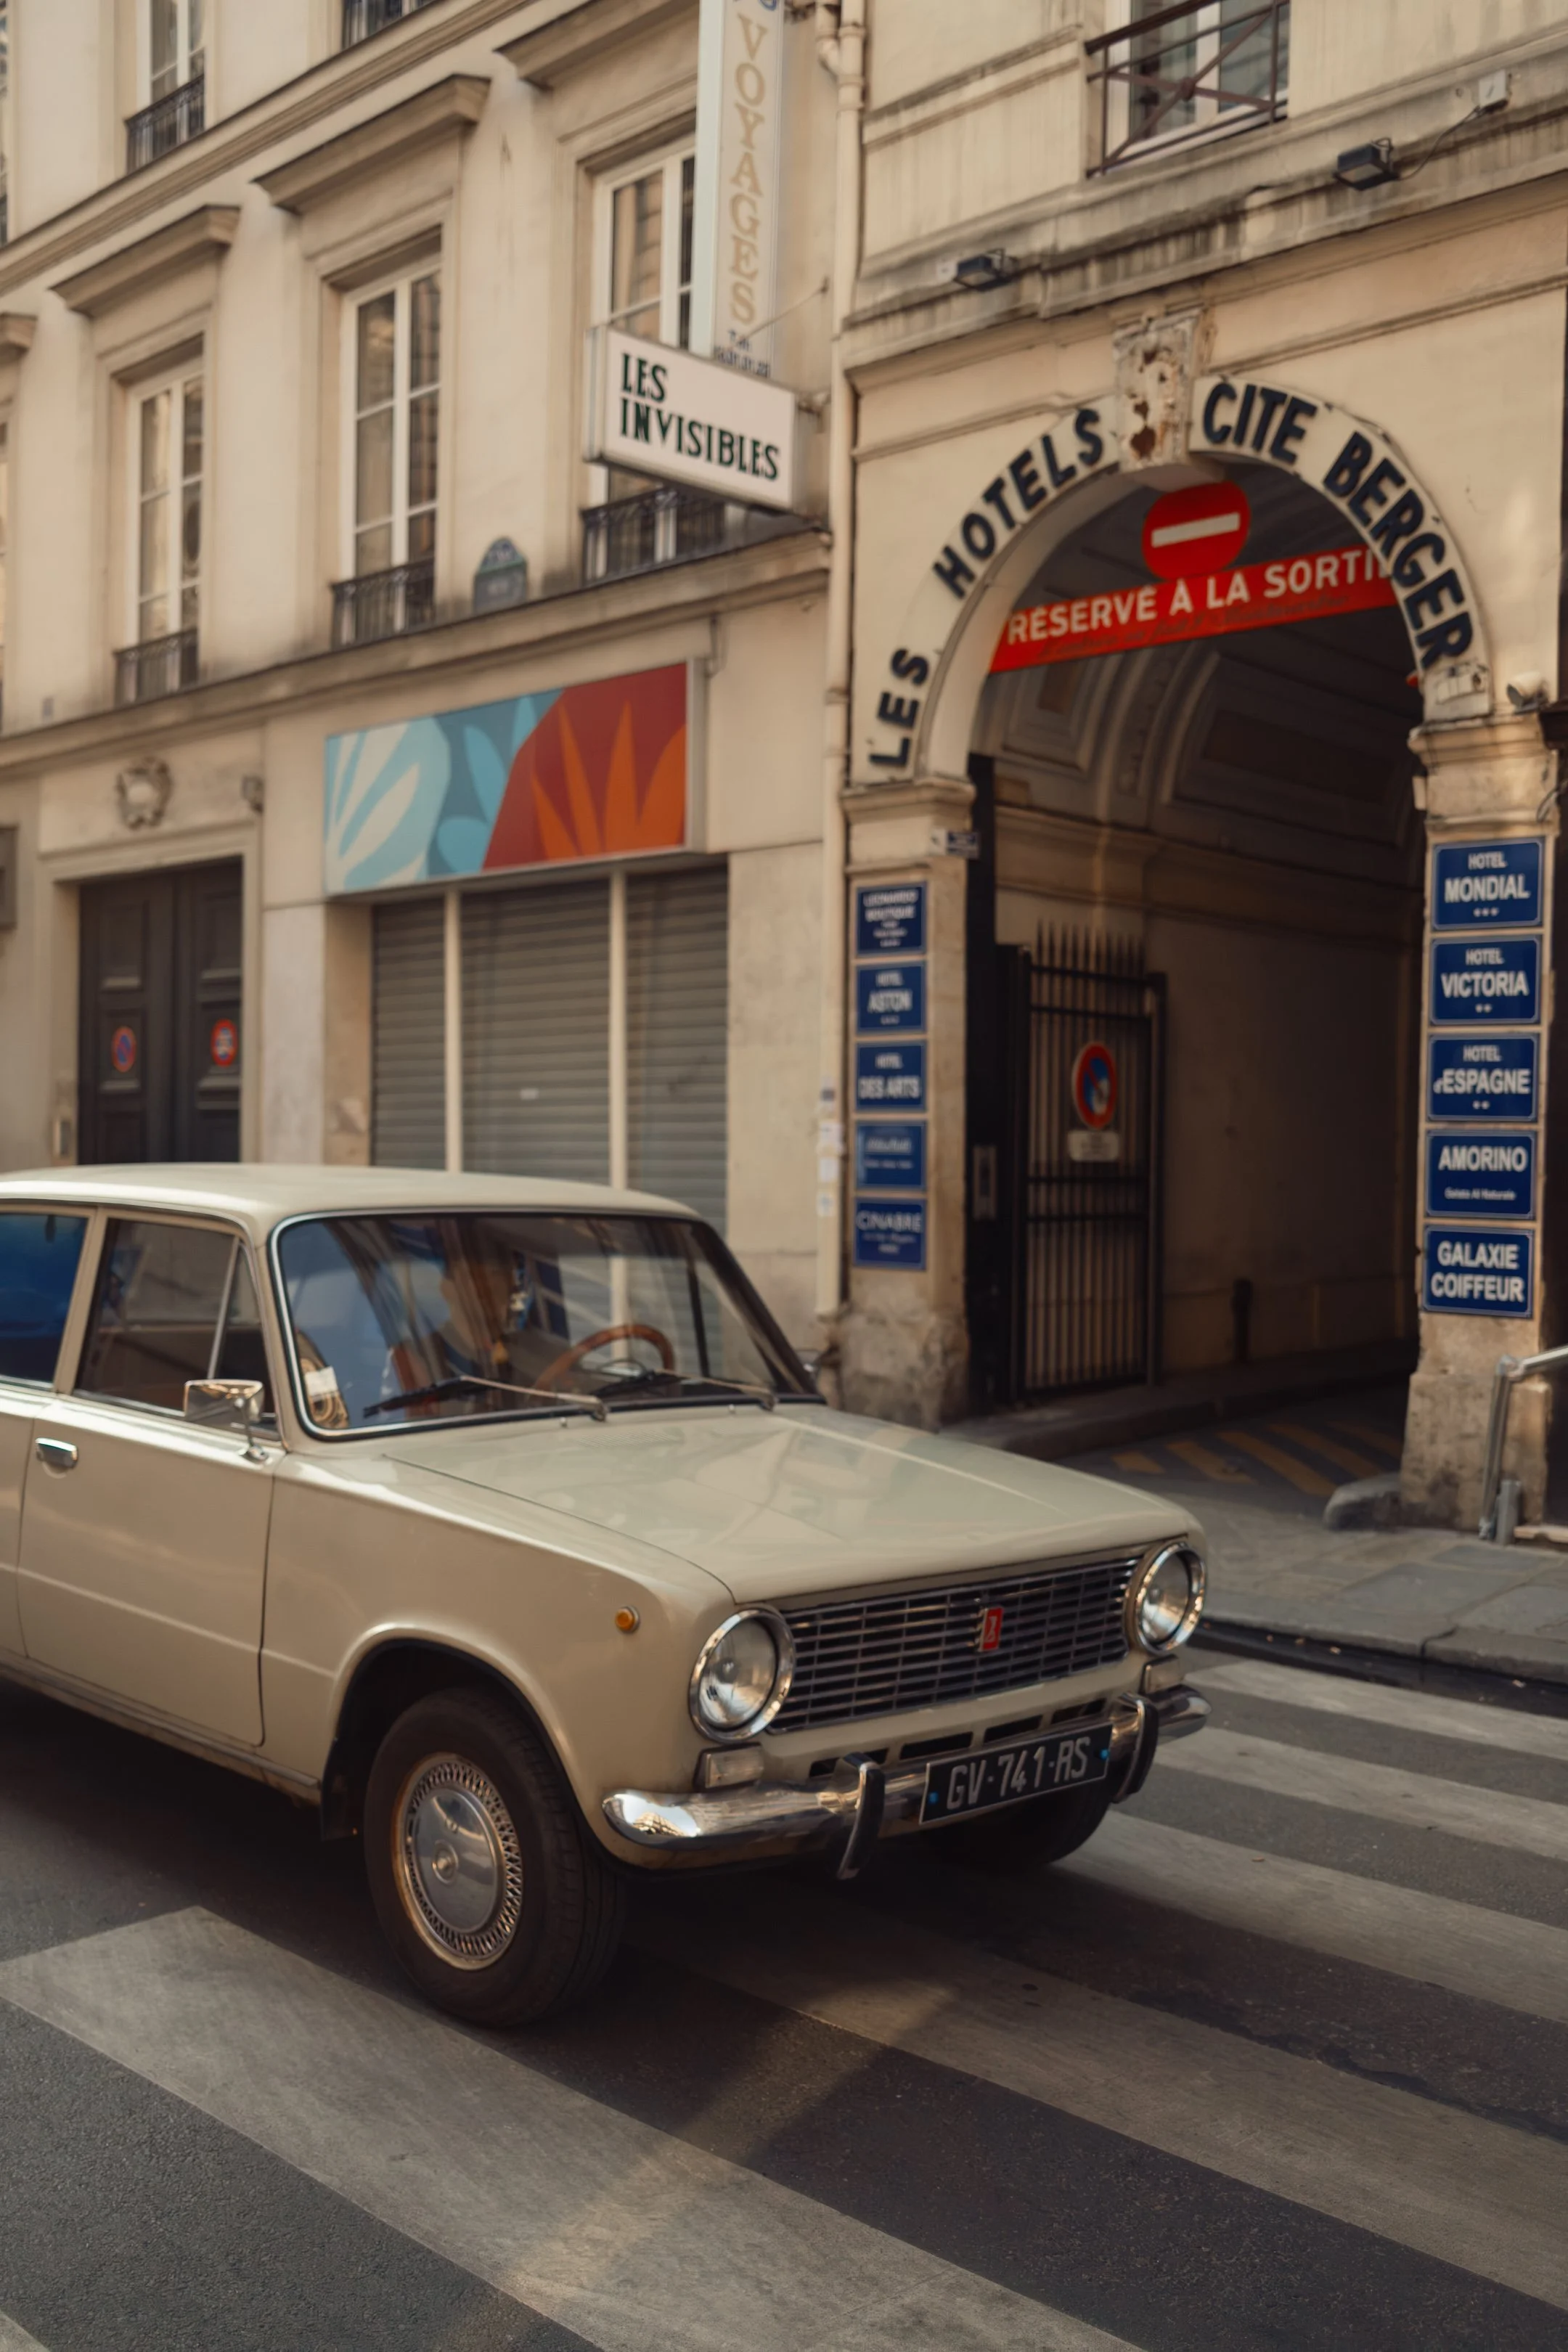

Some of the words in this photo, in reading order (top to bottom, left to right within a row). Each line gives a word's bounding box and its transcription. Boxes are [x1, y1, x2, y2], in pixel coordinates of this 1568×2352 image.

[727, 12, 769, 326] VOYAGES
[621, 353, 667, 402] LES
[621, 398, 780, 481] INVISIBLES
[868, 649, 930, 769] LES
[932, 408, 1104, 600] HOTELS
[1202, 382, 1318, 465] CITE
[1206, 571, 1251, 609] LA
[1468, 851, 1507, 870] HOTEL
[1443, 873, 1531, 904] MONDIAL
[1465, 947, 1505, 965] HOTEL
[1440, 971, 1530, 999] VICTORIA
[1463, 1045, 1502, 1063] HOTEL
[1439, 1146, 1528, 1172] AMORINO
[1437, 1241, 1519, 1270] GALAXIE
[1431, 1273, 1525, 1302] COIFFEUR
[947, 1736, 1091, 1810] GV-741-RS
